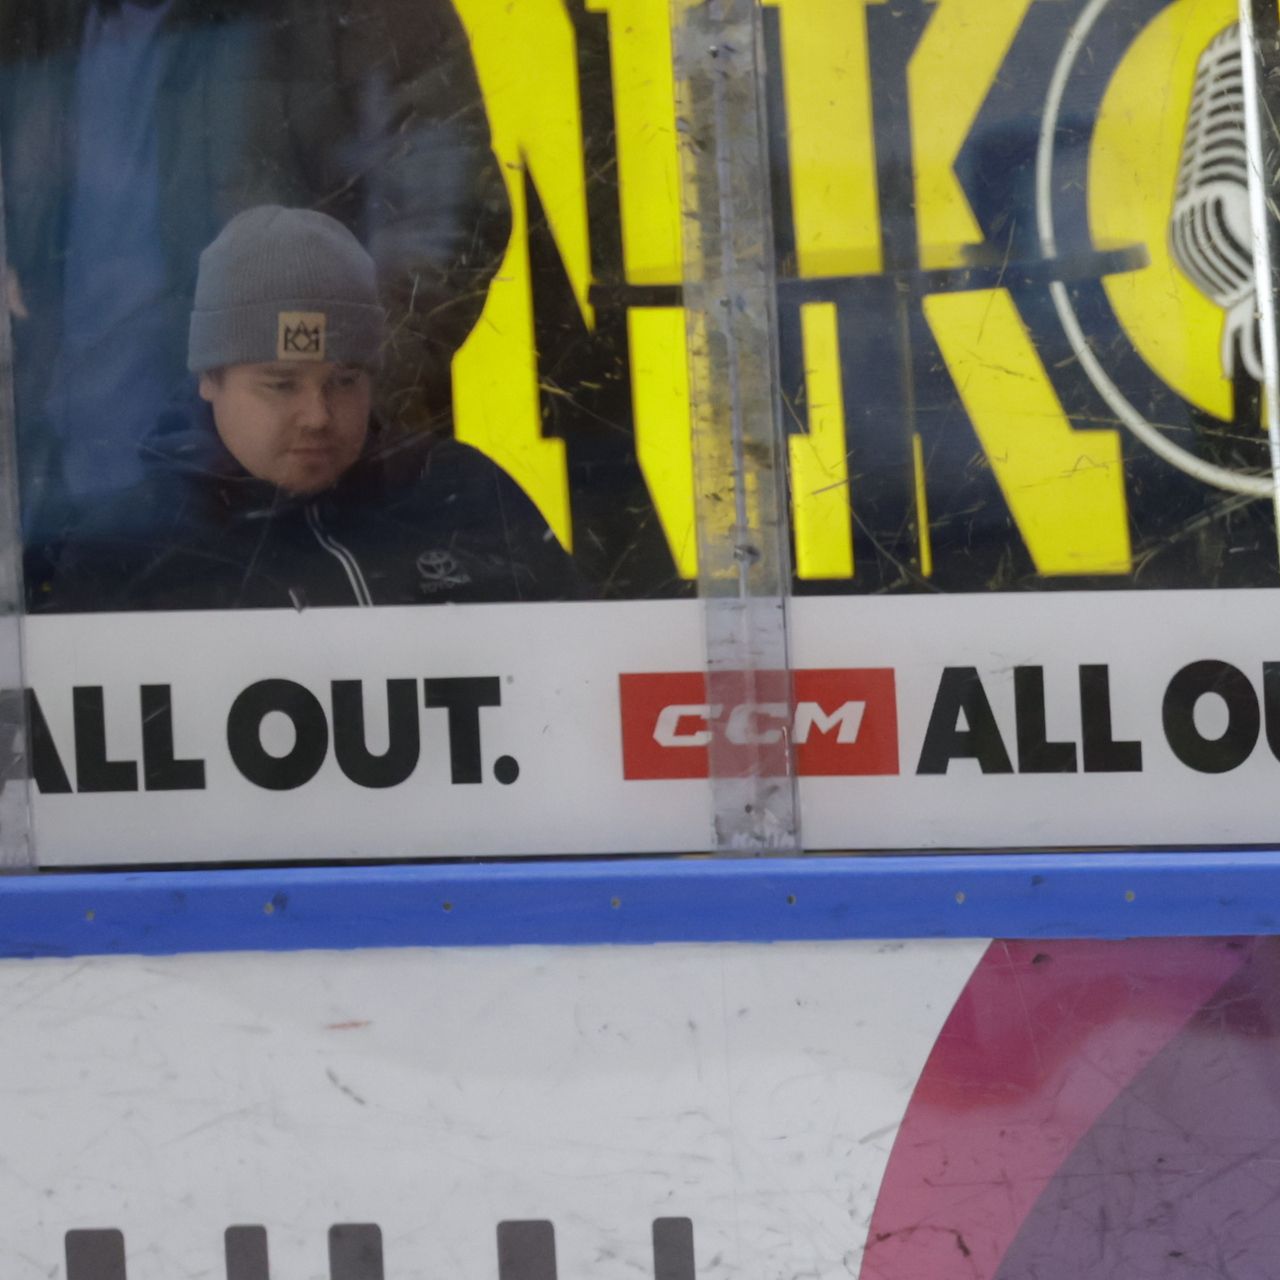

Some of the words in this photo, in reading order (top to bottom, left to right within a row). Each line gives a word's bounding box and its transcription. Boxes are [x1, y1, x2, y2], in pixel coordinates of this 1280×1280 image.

[227, 676, 520, 792] OUT.
[652, 699, 866, 748] CCM
[916, 664, 1143, 776] ALL
